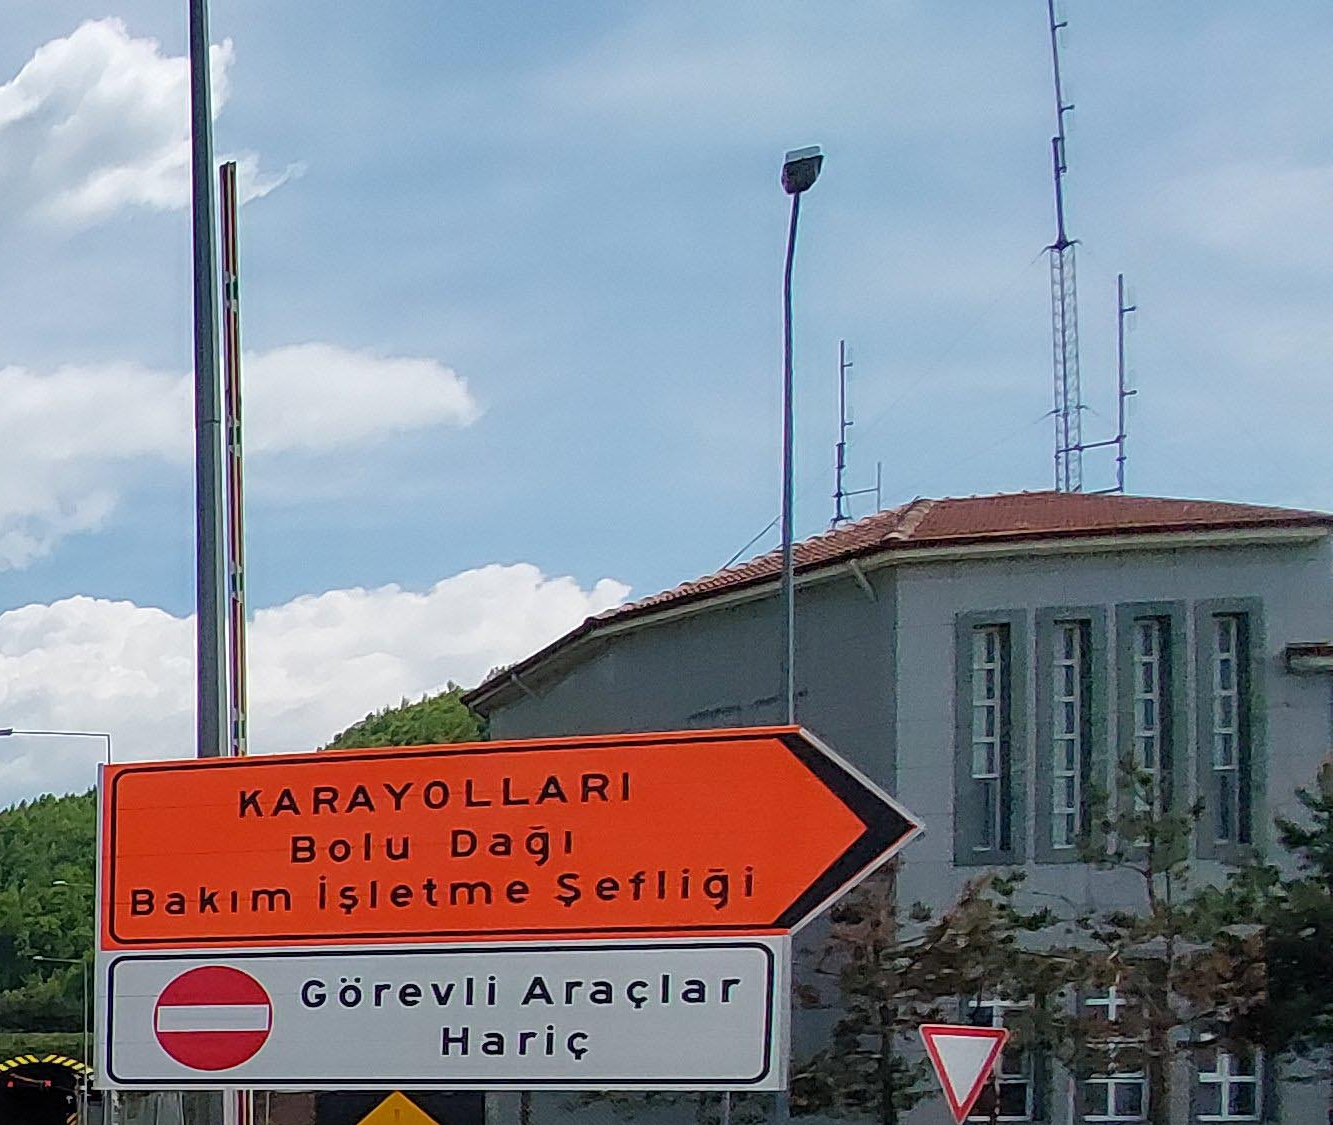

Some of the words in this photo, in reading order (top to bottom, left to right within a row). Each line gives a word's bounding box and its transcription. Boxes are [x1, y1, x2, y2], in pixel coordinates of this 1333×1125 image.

[240, 773, 630, 818] KARAYOLLARI
[290, 831, 410, 863] Bolu
[451, 826, 573, 867] Dağı
[130, 887, 291, 916] Bakım
[320, 876, 530, 915] İşletme
[555, 867, 753, 911] Şefliği
[301, 975, 497, 1008] Görevli
[520, 974, 741, 1010] Araçlar
[441, 1025, 589, 1061] Hariç
